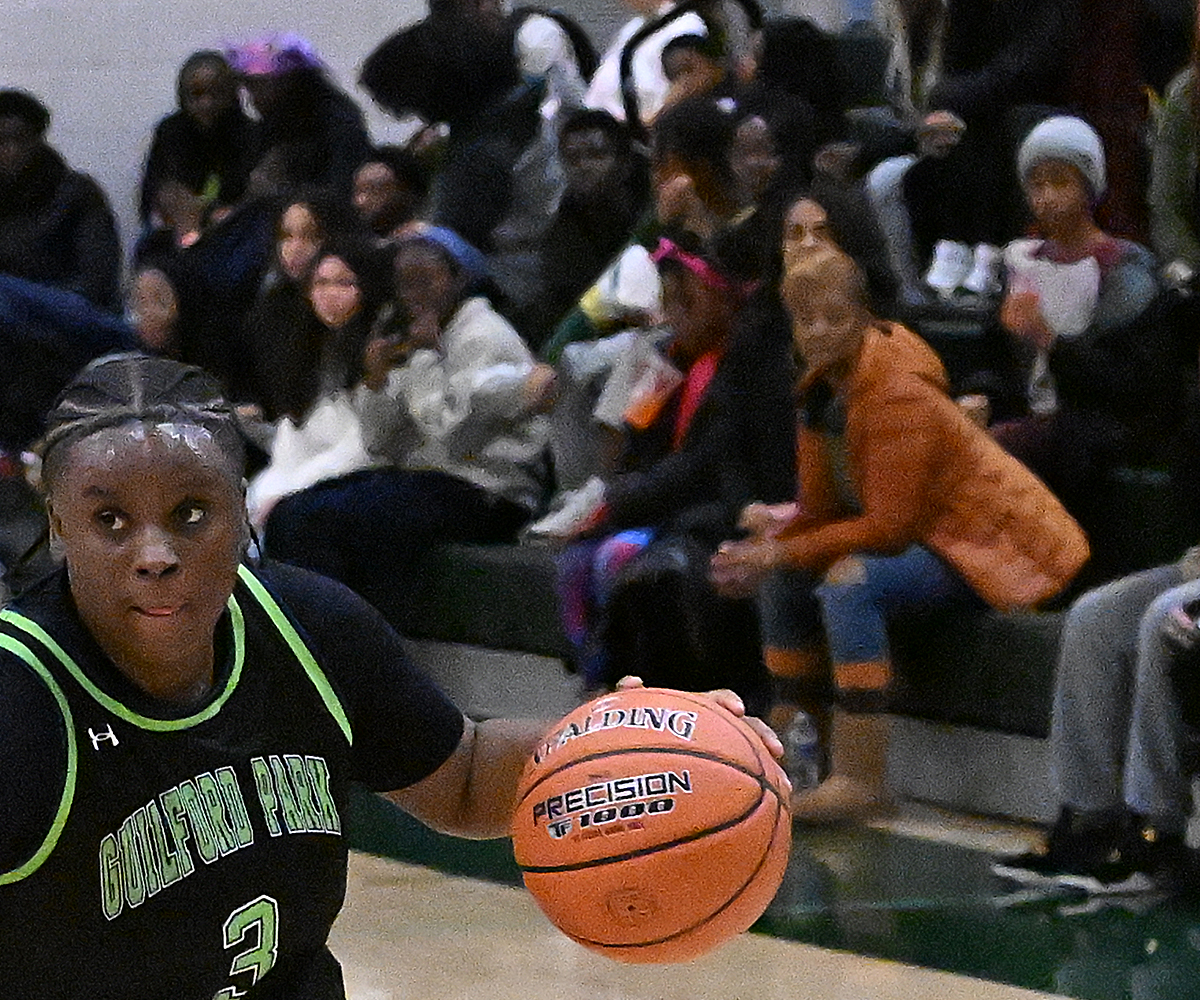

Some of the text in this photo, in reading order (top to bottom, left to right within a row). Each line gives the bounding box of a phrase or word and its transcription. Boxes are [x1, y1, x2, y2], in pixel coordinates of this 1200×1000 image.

[533, 770, 693, 826] PRECISION
[579, 798, 675, 828] 1000
[99, 754, 341, 921] GUILFORD PARK
